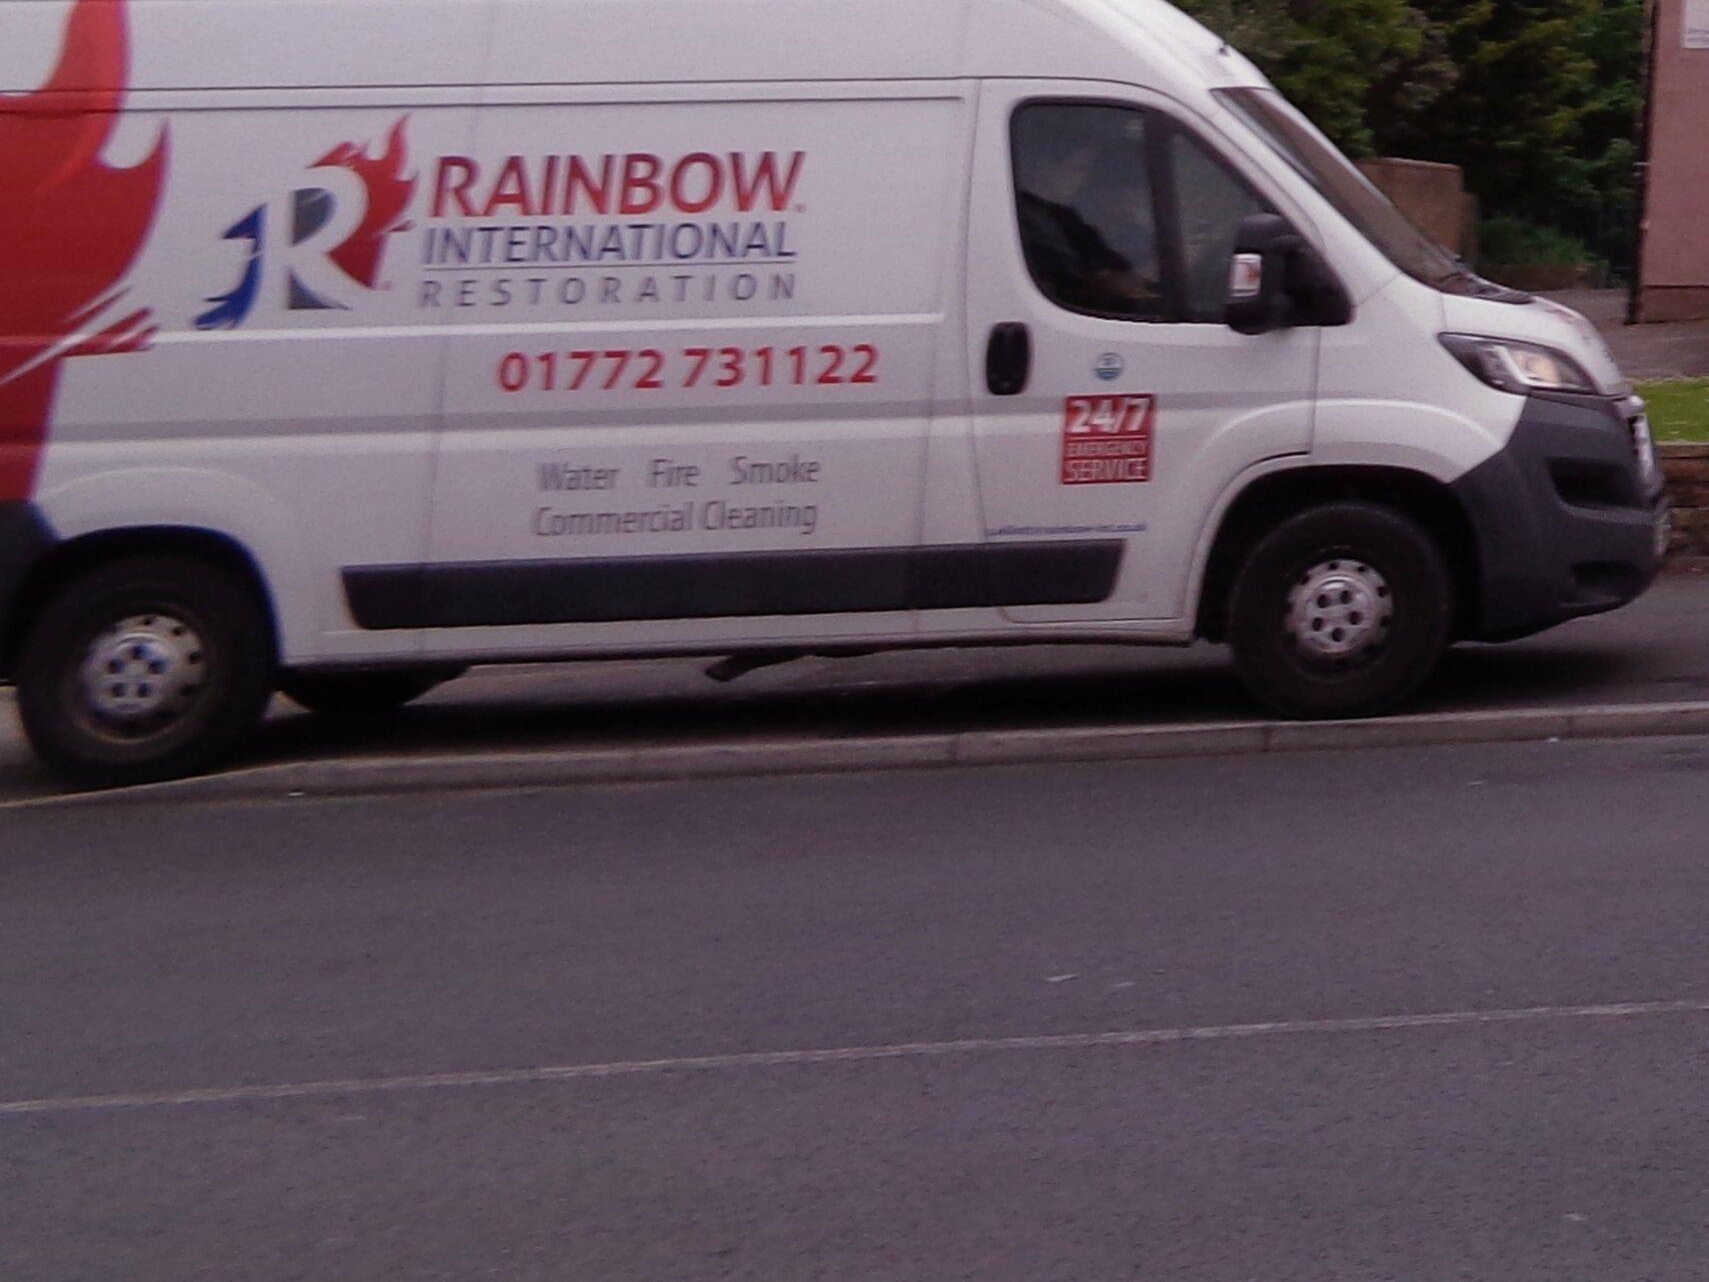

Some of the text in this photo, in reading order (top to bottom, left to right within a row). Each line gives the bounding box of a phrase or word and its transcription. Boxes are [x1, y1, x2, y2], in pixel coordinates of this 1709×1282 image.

[428, 151, 806, 218] RAINBOW
[420, 221, 798, 265] INTERNATIONAL
[418, 273, 797, 308] RESTORATION
[496, 343, 880, 392] 01772 731122
[1069, 398, 1151, 434] 24/7
[538, 455, 822, 490] Water Fire Smoke
[1065, 458, 1148, 481] SERVICE
[531, 499, 818, 536] Commercial Cleaning
